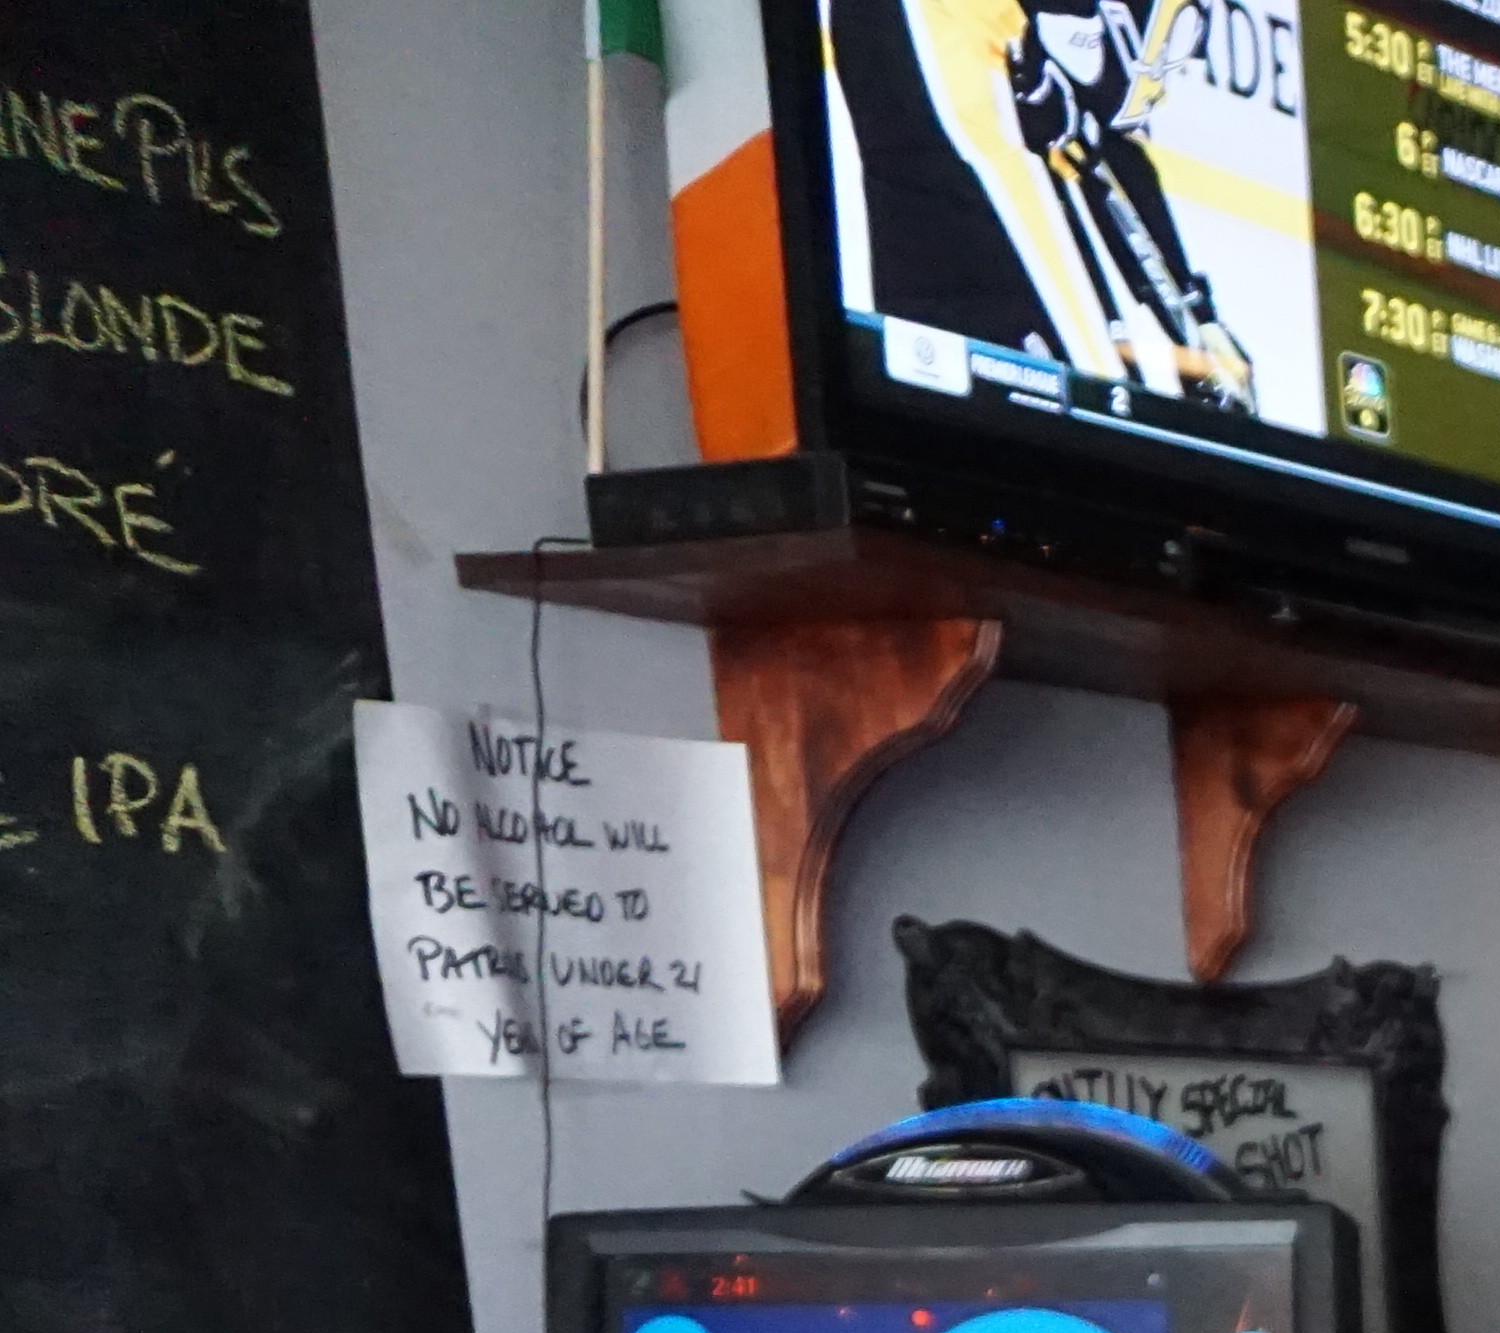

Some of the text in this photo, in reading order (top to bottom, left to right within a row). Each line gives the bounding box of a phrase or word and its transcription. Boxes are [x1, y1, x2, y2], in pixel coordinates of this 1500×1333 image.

[1344, 10, 1415, 80] 5:30
[1395, 121, 1419, 171] 6
[1353, 192, 1426, 257] 6:30
[1445, 231, 1483, 268] NHL
[1361, 288, 1430, 354] 7:30
[72, 752, 228, 853] IPA
[408, 788, 460, 840] NO
[604, 820, 670, 851] WILL
[415, 870, 487, 913] BE
[616, 888, 649, 920] TO
[550, 953, 664, 992] UNDER
[669, 962, 702, 993] 21
[558, 1019, 593, 1053] OF
[612, 1011, 685, 1054] AGE
